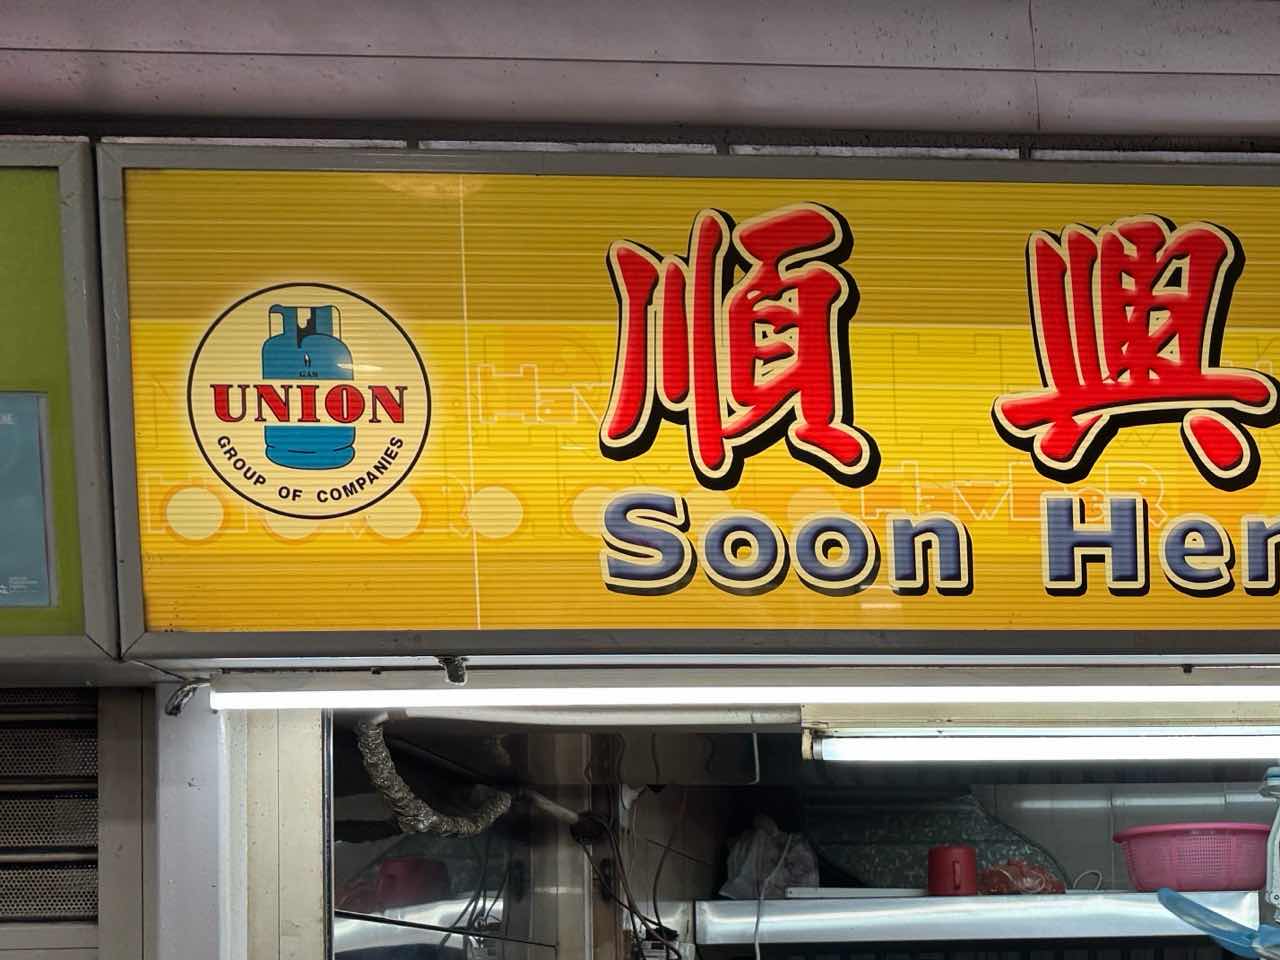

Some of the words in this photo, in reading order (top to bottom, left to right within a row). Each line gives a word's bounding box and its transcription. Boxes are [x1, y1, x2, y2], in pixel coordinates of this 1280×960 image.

[210, 384, 408, 424] UNION
[217, 435, 267, 487] GROUP
[278, 486, 303, 502] OF
[316, 436, 404, 503] COMPANIES
[603, 490, 974, 596] Soon
